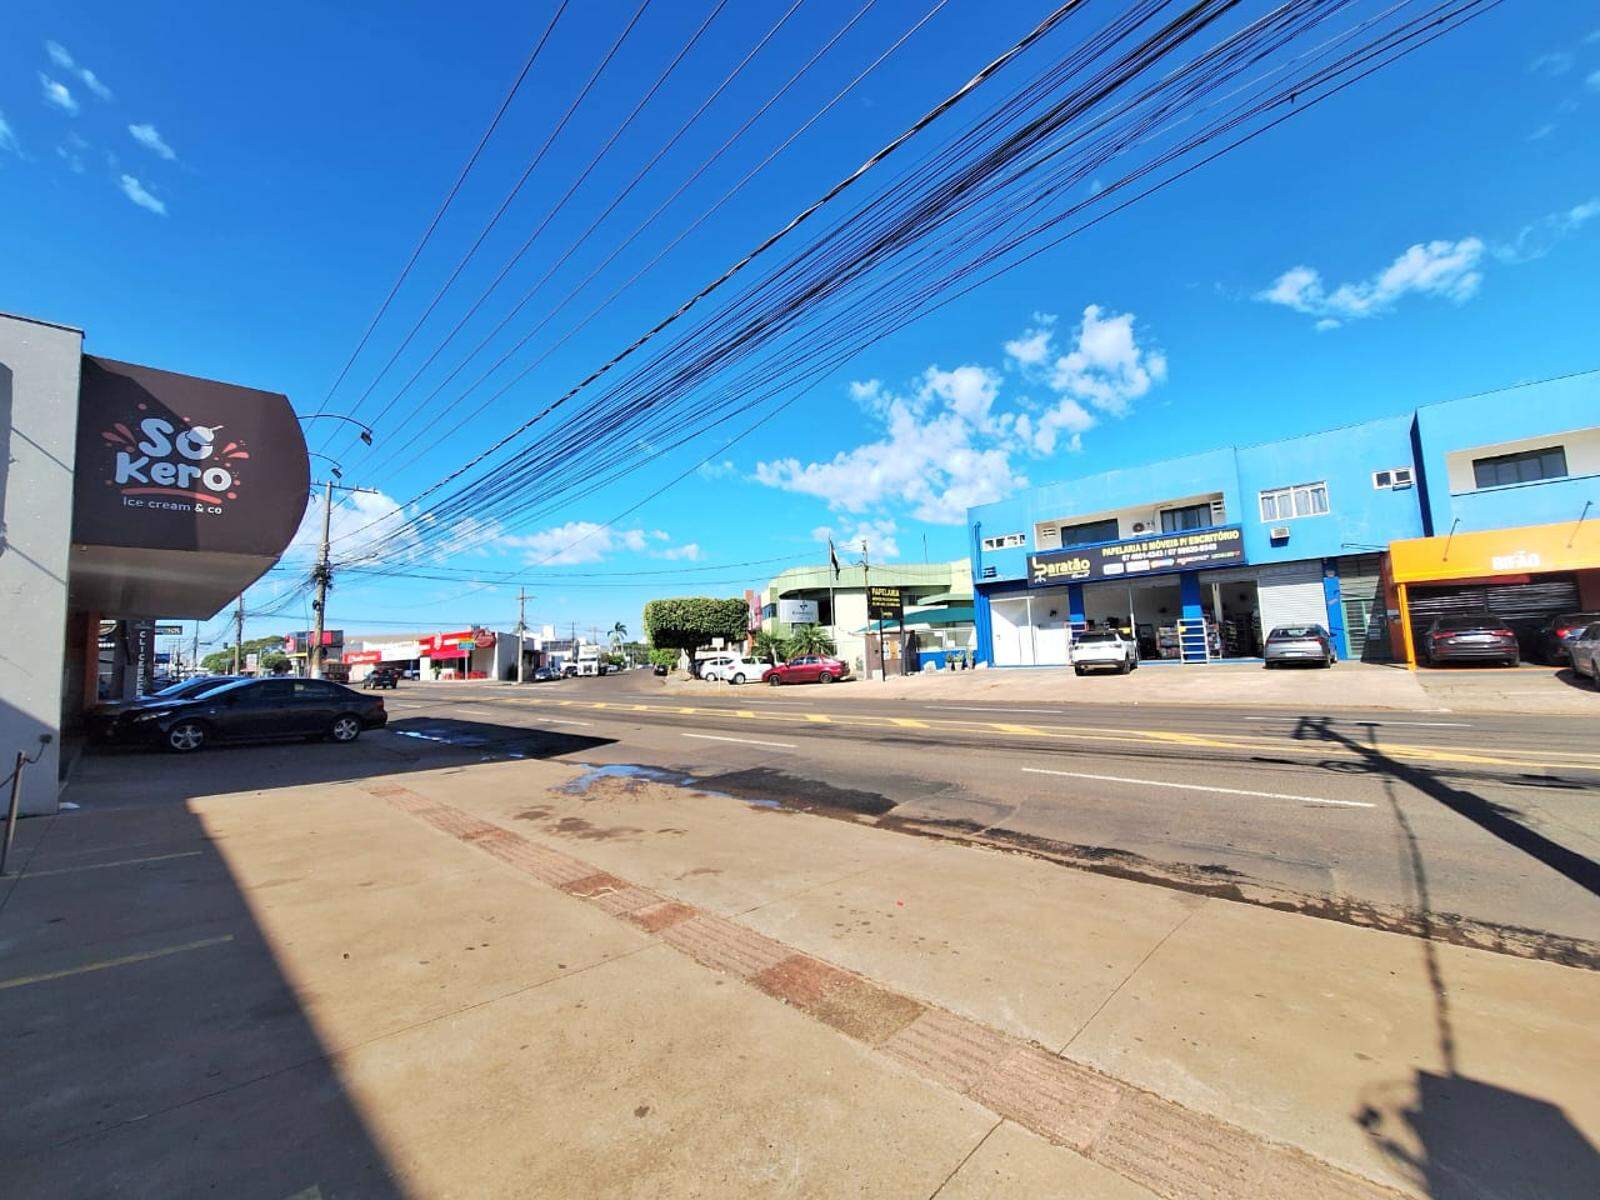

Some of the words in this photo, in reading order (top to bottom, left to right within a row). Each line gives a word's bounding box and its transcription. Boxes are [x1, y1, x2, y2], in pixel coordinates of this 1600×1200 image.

[115, 451, 233, 492] Kero
[148, 500, 191, 511] cream
[194, 503, 204, 513] &
[207, 505, 222, 515] co
